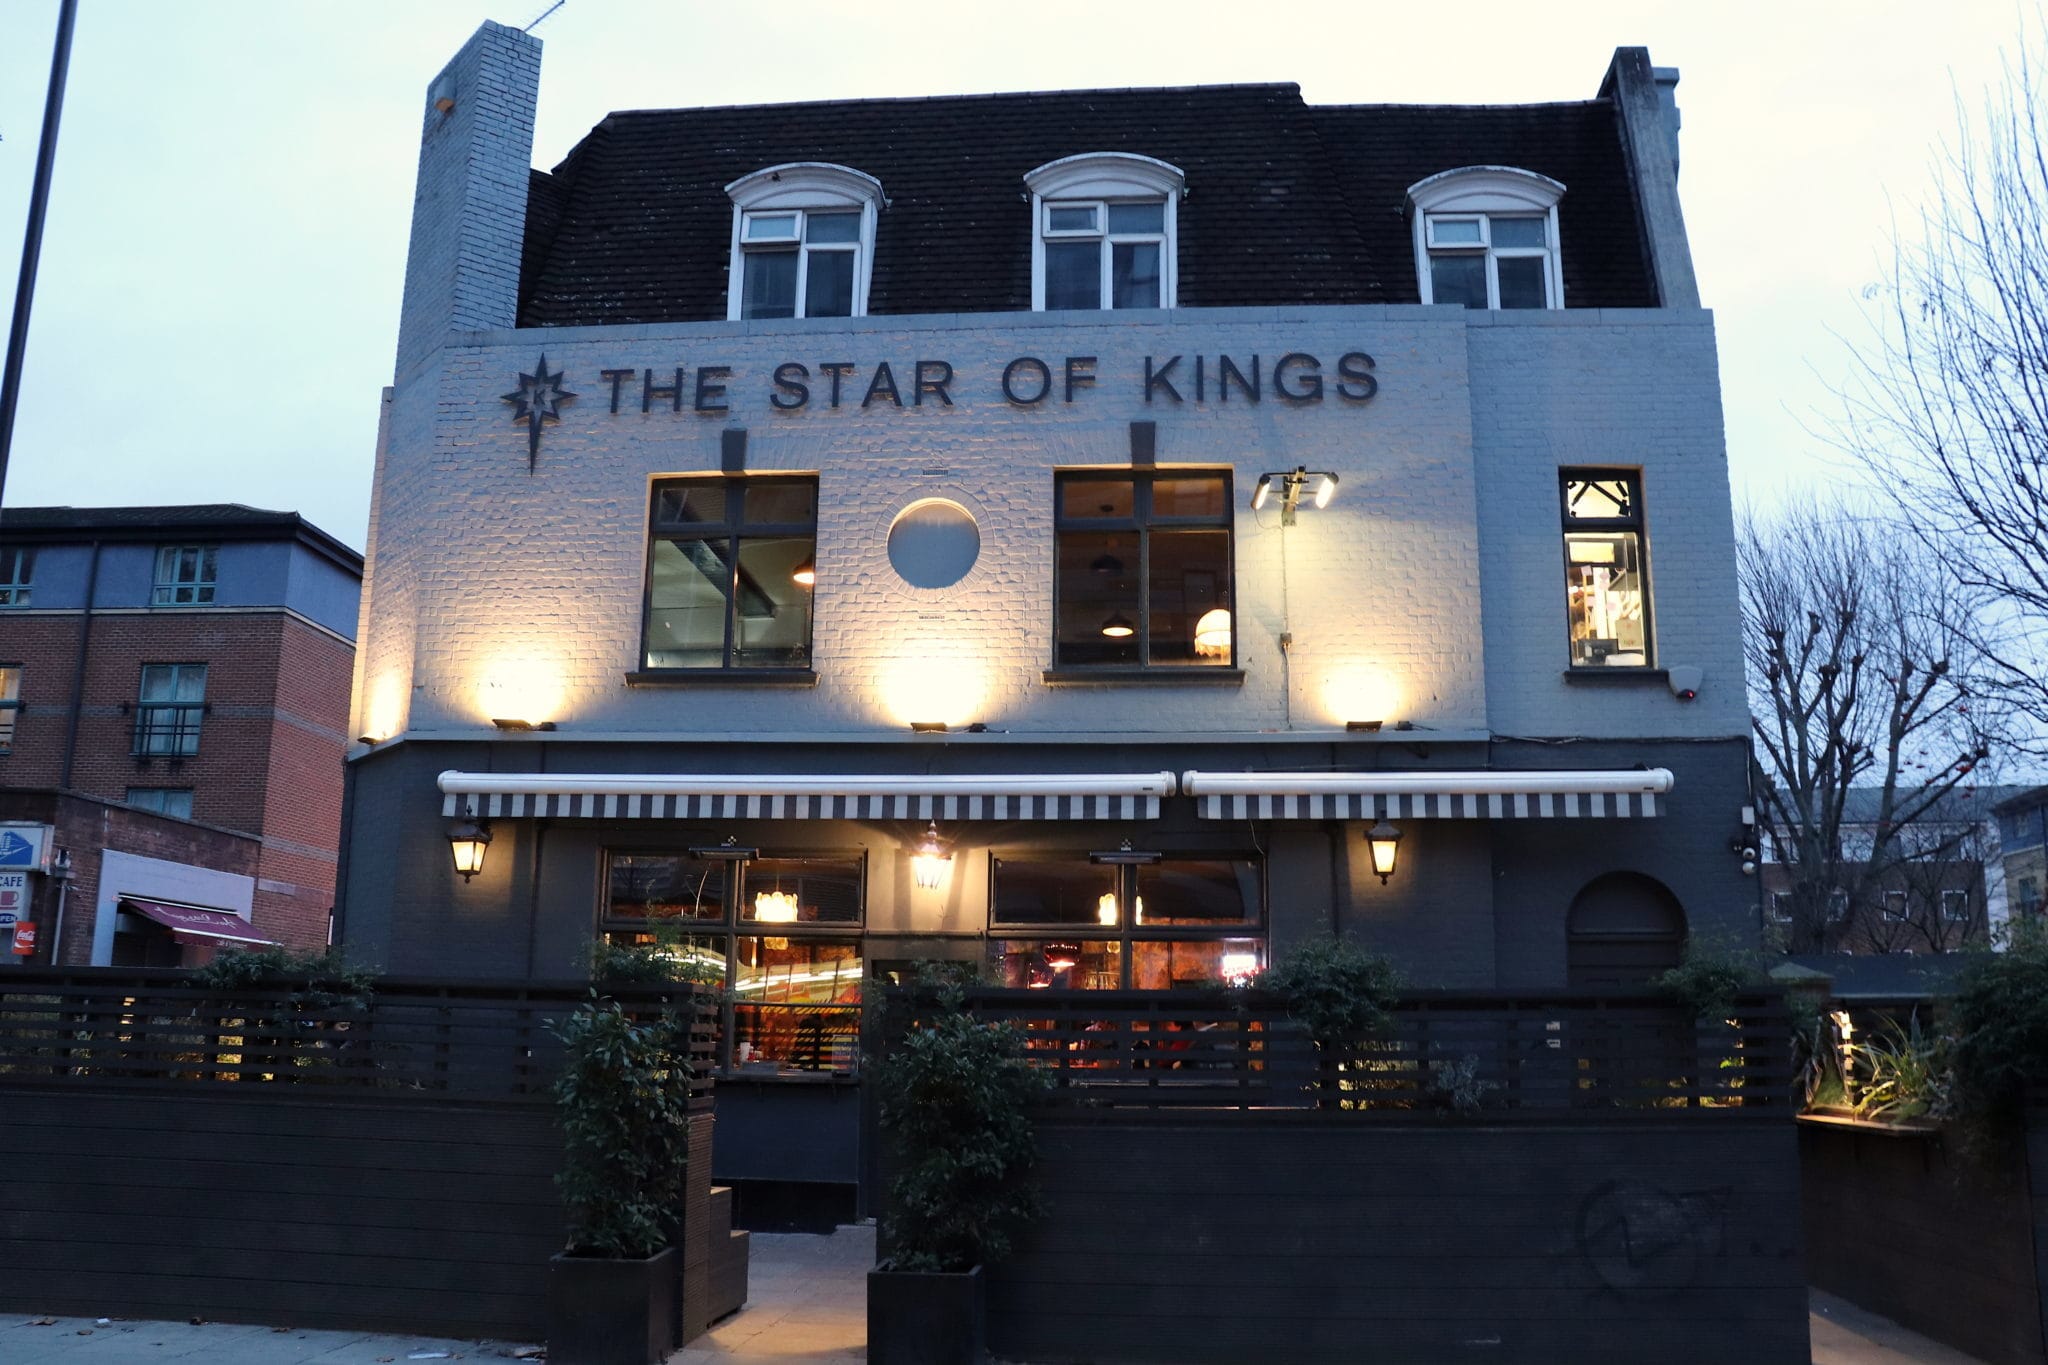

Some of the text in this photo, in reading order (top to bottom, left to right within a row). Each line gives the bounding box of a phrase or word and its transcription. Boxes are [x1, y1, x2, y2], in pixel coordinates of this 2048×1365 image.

[533, 388, 546, 405] K
[600, 351, 1379, 414] THE STAR OF KINGS
